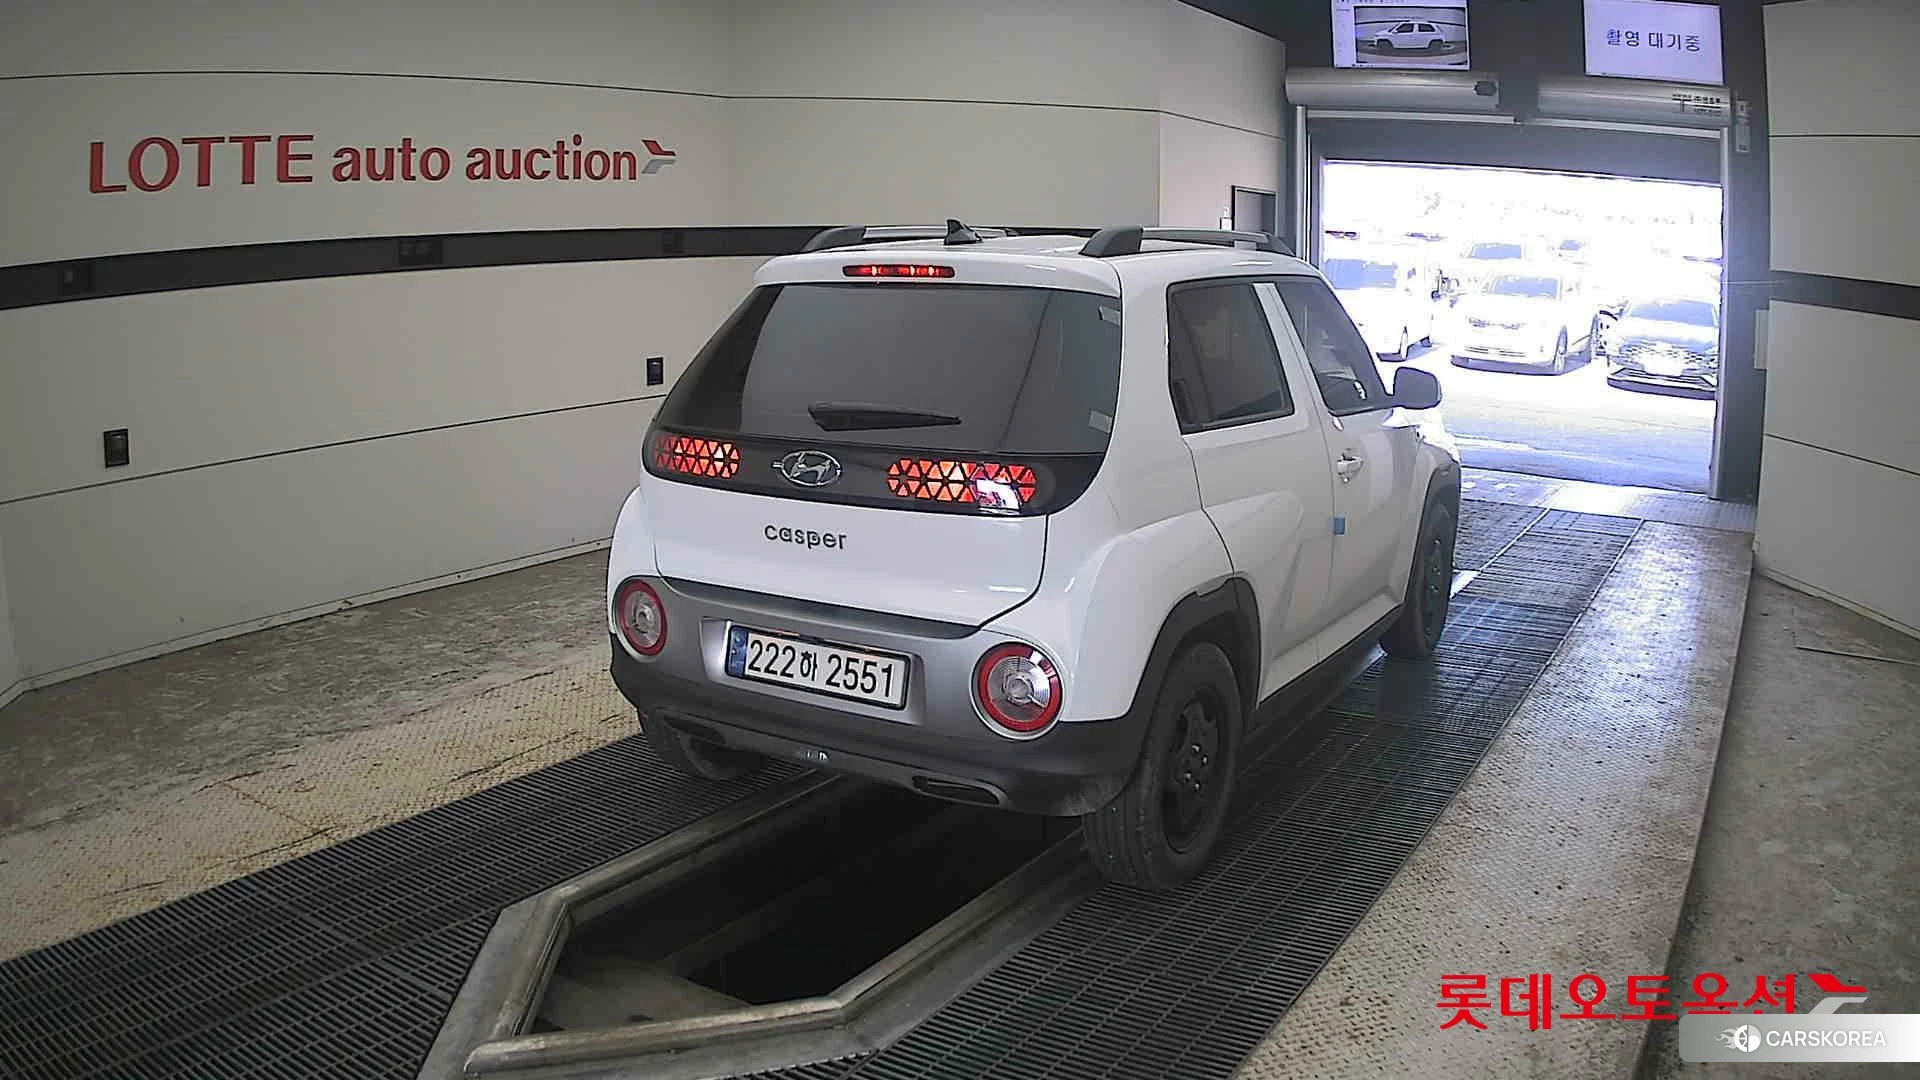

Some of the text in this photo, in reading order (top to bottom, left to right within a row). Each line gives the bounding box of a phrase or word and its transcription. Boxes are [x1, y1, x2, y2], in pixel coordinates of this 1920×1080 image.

[1607, 28, 1700, 52] 촬영 대기중
[89, 133, 638, 193] LOTTE auto auction
[764, 524, 847, 549] casper
[748, 639, 893, 698] 222하 2551
